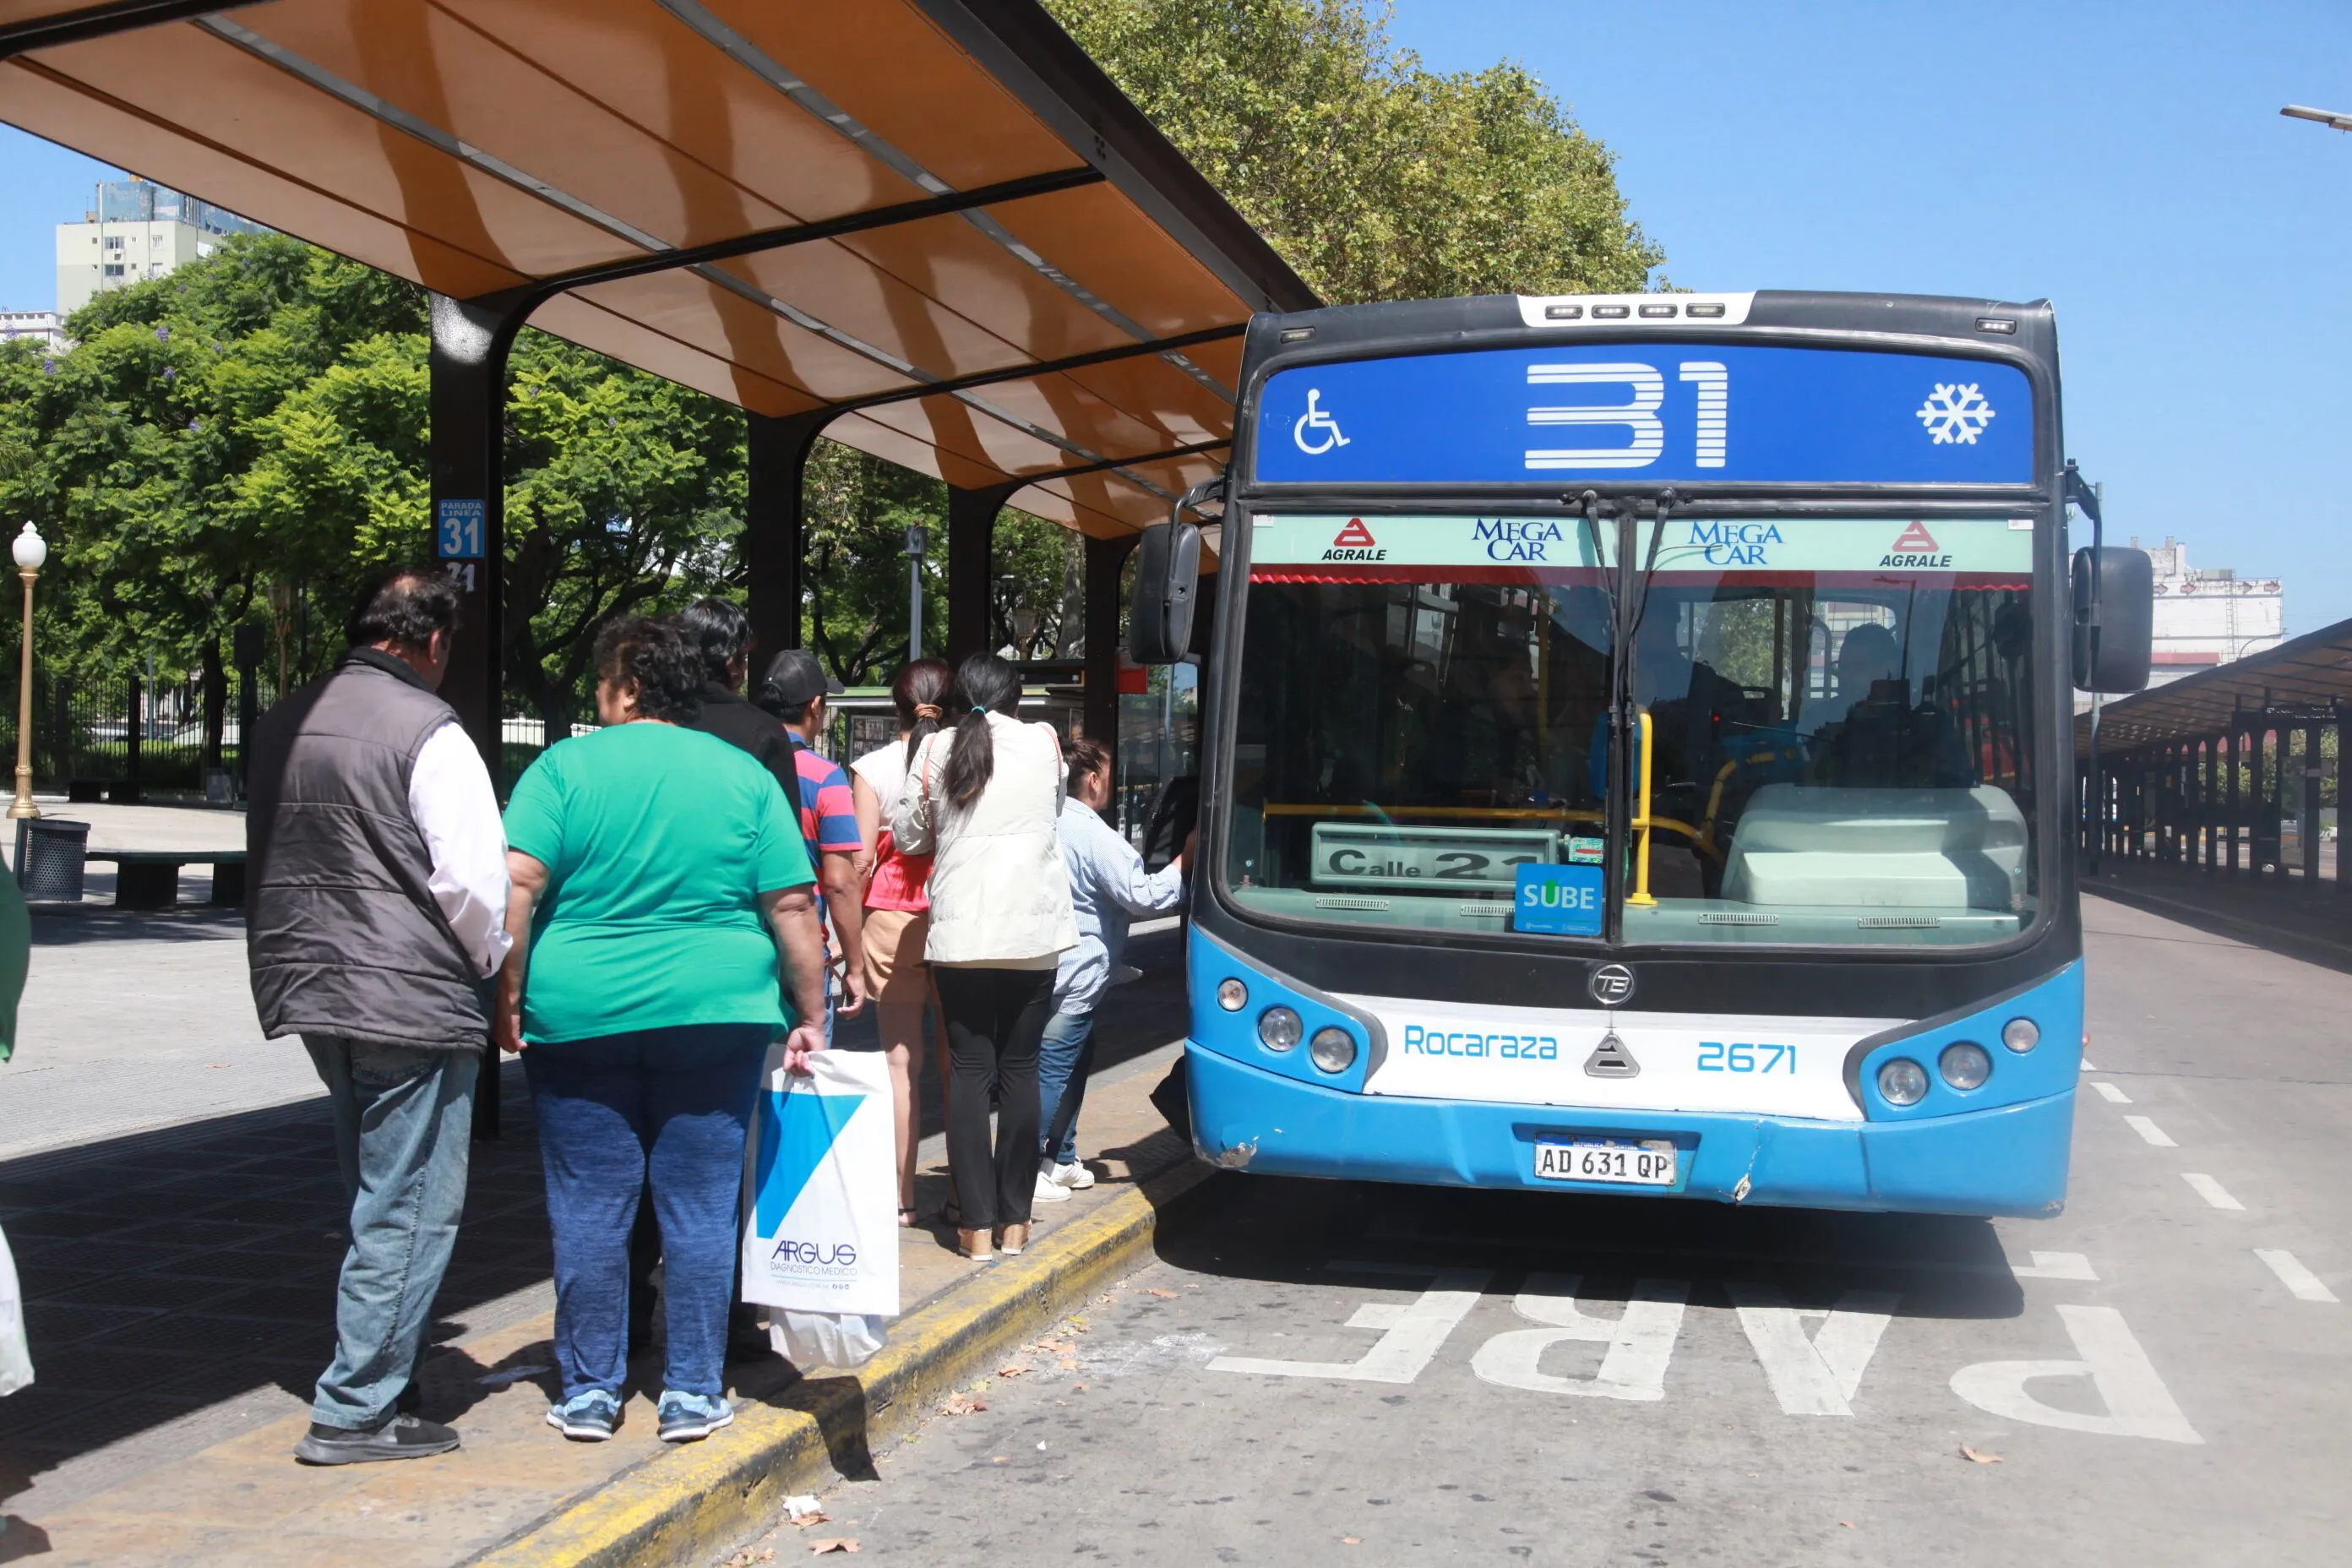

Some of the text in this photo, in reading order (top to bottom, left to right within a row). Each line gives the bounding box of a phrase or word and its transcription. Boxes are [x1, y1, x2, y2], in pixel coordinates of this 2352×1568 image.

[1525, 362, 1728, 470] 31
[444, 518, 478, 554] 31
[1472, 518, 1565, 542] MEGA
[1688, 520, 1786, 544] MEGA
[1321, 549, 1387, 561] AGRALE
[1487, 539, 1548, 561] CAR
[1704, 542, 1769, 565] CAR
[1879, 554, 1952, 567] AGRALE
[1329, 849, 1421, 878] Calle
[1523, 884, 1595, 910] SUBE
[1405, 1025, 1557, 1059] Rocaraza
[1697, 1042, 1796, 1075] 2671
[1542, 1149, 1668, 1179] AD 631 QP
[771, 1240, 857, 1266] ARGUS
[770, 1261, 858, 1277] DIAGNOSTICO MEDICO
[1206, 1260, 2205, 1445] PARE
